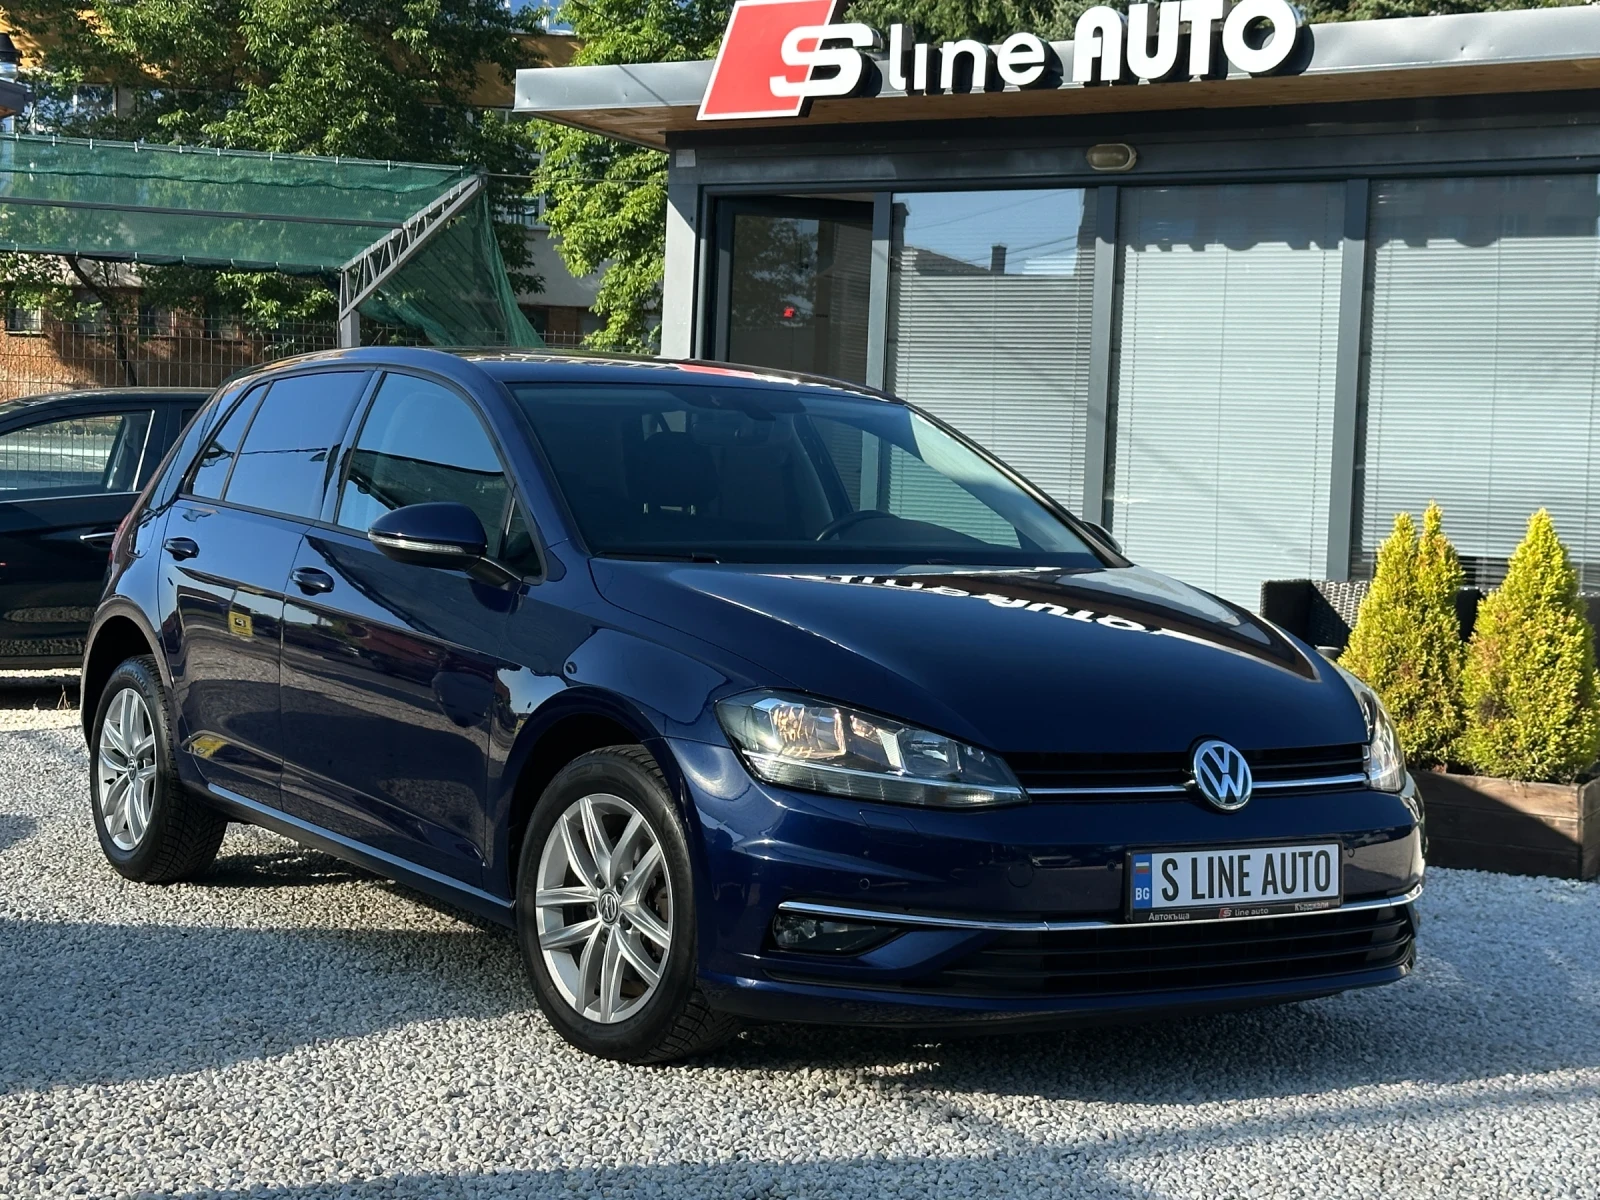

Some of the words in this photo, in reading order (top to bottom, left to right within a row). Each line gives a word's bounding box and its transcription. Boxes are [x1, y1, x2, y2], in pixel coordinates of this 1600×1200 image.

[769, 23, 873, 97] S
[888, 23, 1046, 90] line
[1072, 0, 1297, 82] AUTO
[1161, 858, 1179, 901] S
[1191, 854, 1251, 900] LINE
[1261, 850, 1331, 896] AUTO
[1135, 888, 1150, 901] BG
[1148, 911, 1190, 921] Автокъща
[1251, 907, 1269, 915] auto
